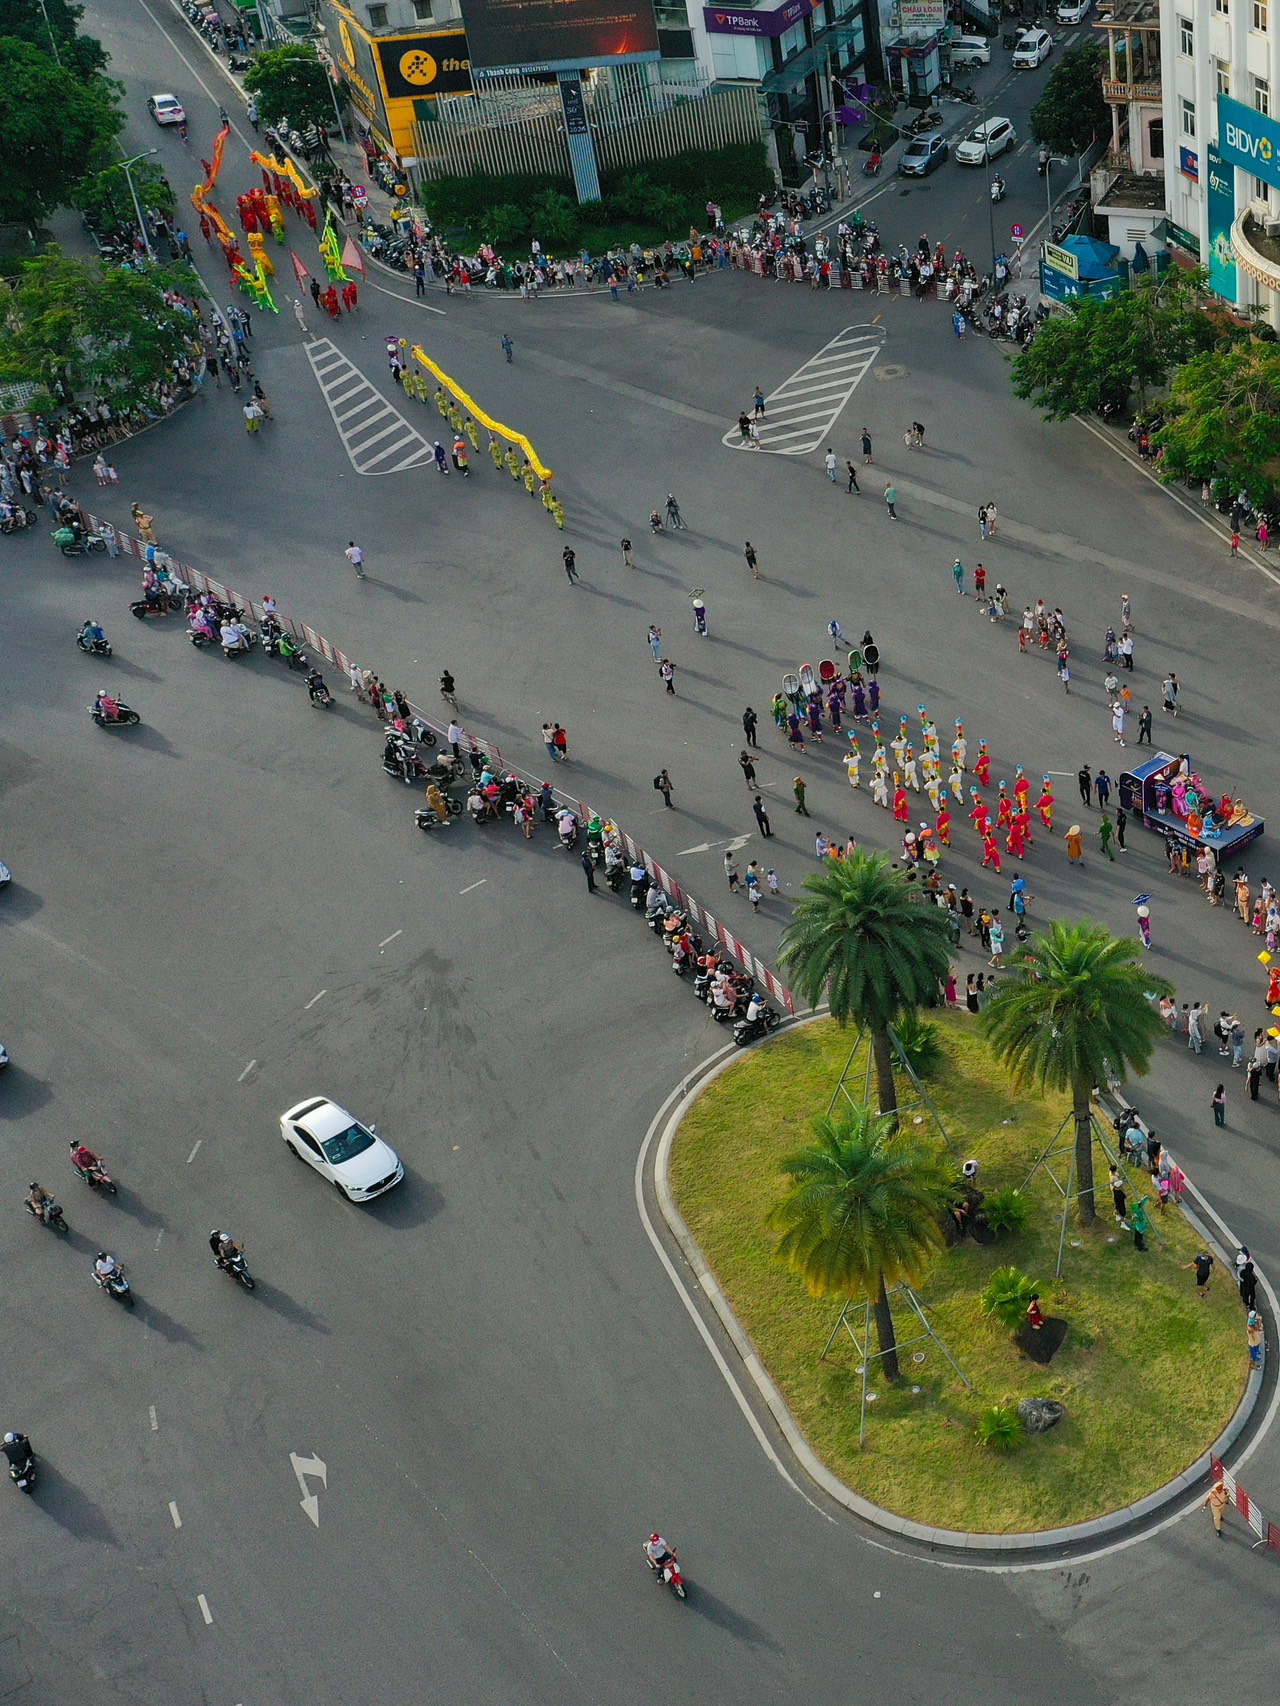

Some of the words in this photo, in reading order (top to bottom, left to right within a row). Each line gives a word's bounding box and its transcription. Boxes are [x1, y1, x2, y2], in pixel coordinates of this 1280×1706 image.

[726, 15, 759, 27] TPBank
[441, 58, 471, 72] the
[1226, 122, 1260, 158] BIDV
